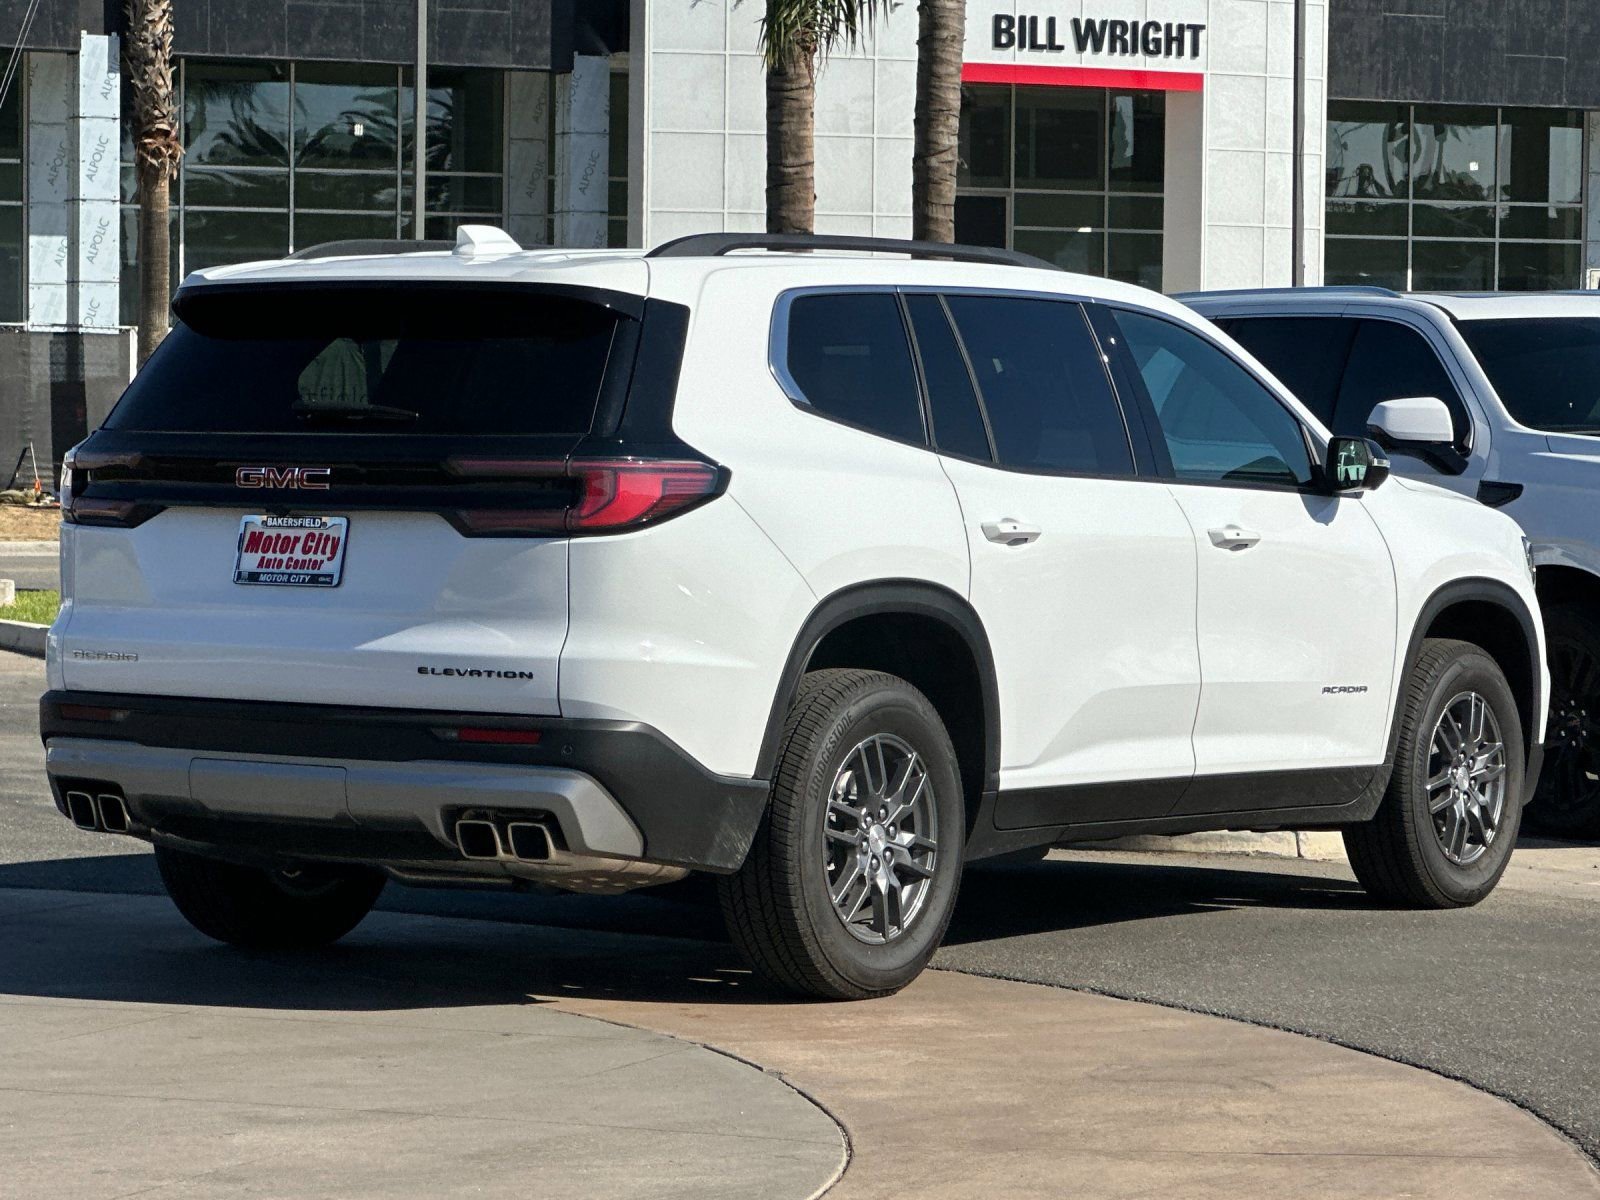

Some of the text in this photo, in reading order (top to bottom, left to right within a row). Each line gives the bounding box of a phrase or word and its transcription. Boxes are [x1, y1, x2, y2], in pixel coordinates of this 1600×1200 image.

[992, 14, 1206, 59] BILL WRIGHT
[85, 135, 109, 182] ALPOLIC
[579, 150, 600, 196] ALPOLIC
[86, 217, 110, 264] ALPOLIC
[235, 467, 331, 490] GMC
[266, 517, 321, 528] BAKERSFIELD
[244, 530, 341, 562] Motor City
[257, 556, 325, 571] Auto Center
[259, 573, 311, 583] MOTOR CITY
[417, 666, 534, 680] ELEVATION
[1322, 685, 1368, 695] ACADIA
[808, 710, 854, 801] BRIDGESTONE
